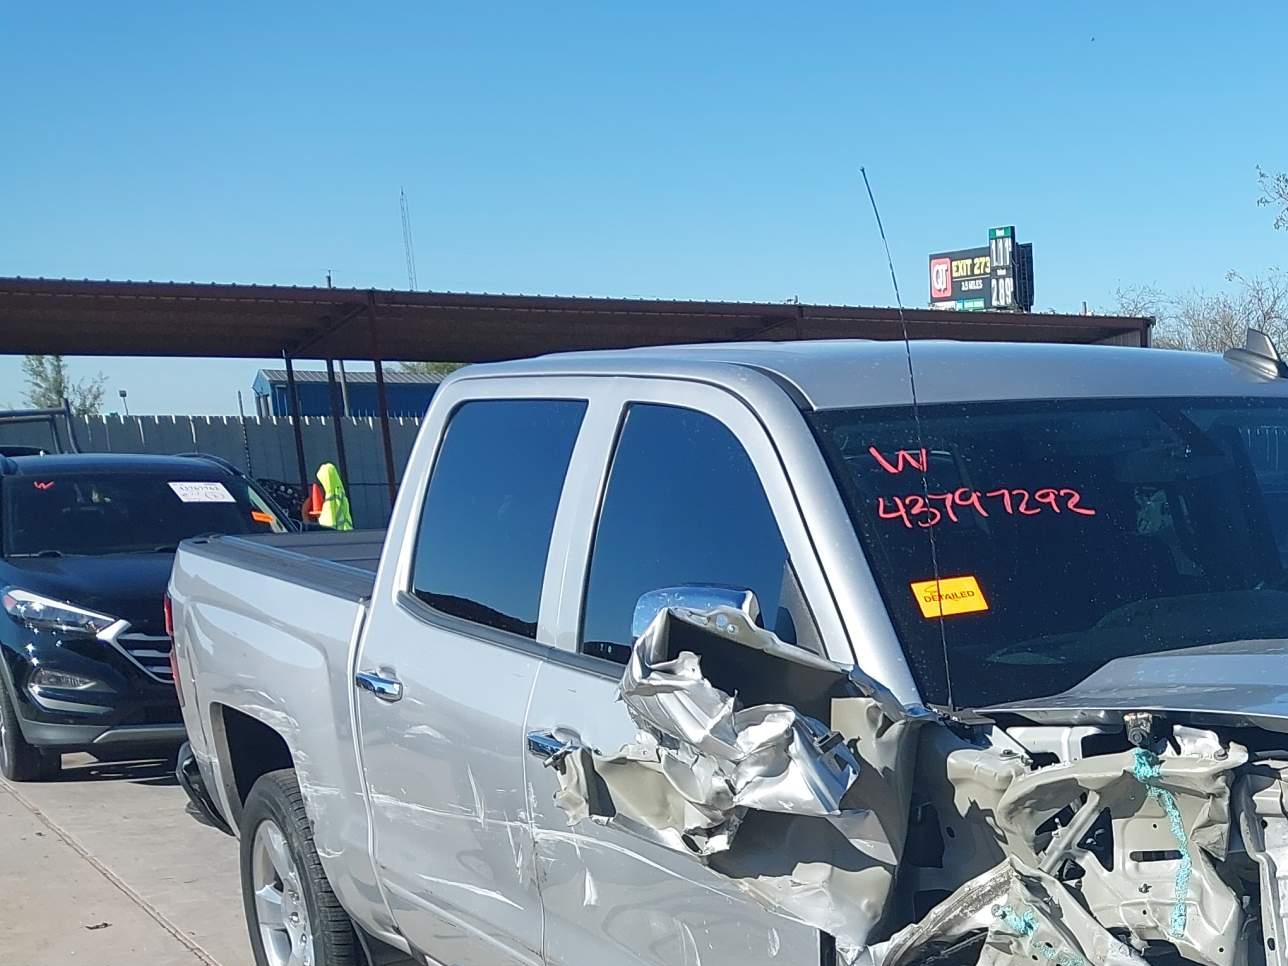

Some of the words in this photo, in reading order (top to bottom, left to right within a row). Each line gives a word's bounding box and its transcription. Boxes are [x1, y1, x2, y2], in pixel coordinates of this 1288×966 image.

[933, 264, 948, 293] QT
[952, 259, 973, 277] EXIT
[974, 256, 991, 275] 273
[868, 447, 928, 474] W
[878, 487, 1096, 529] 43797292
[923, 590, 975, 603] DETAILED
